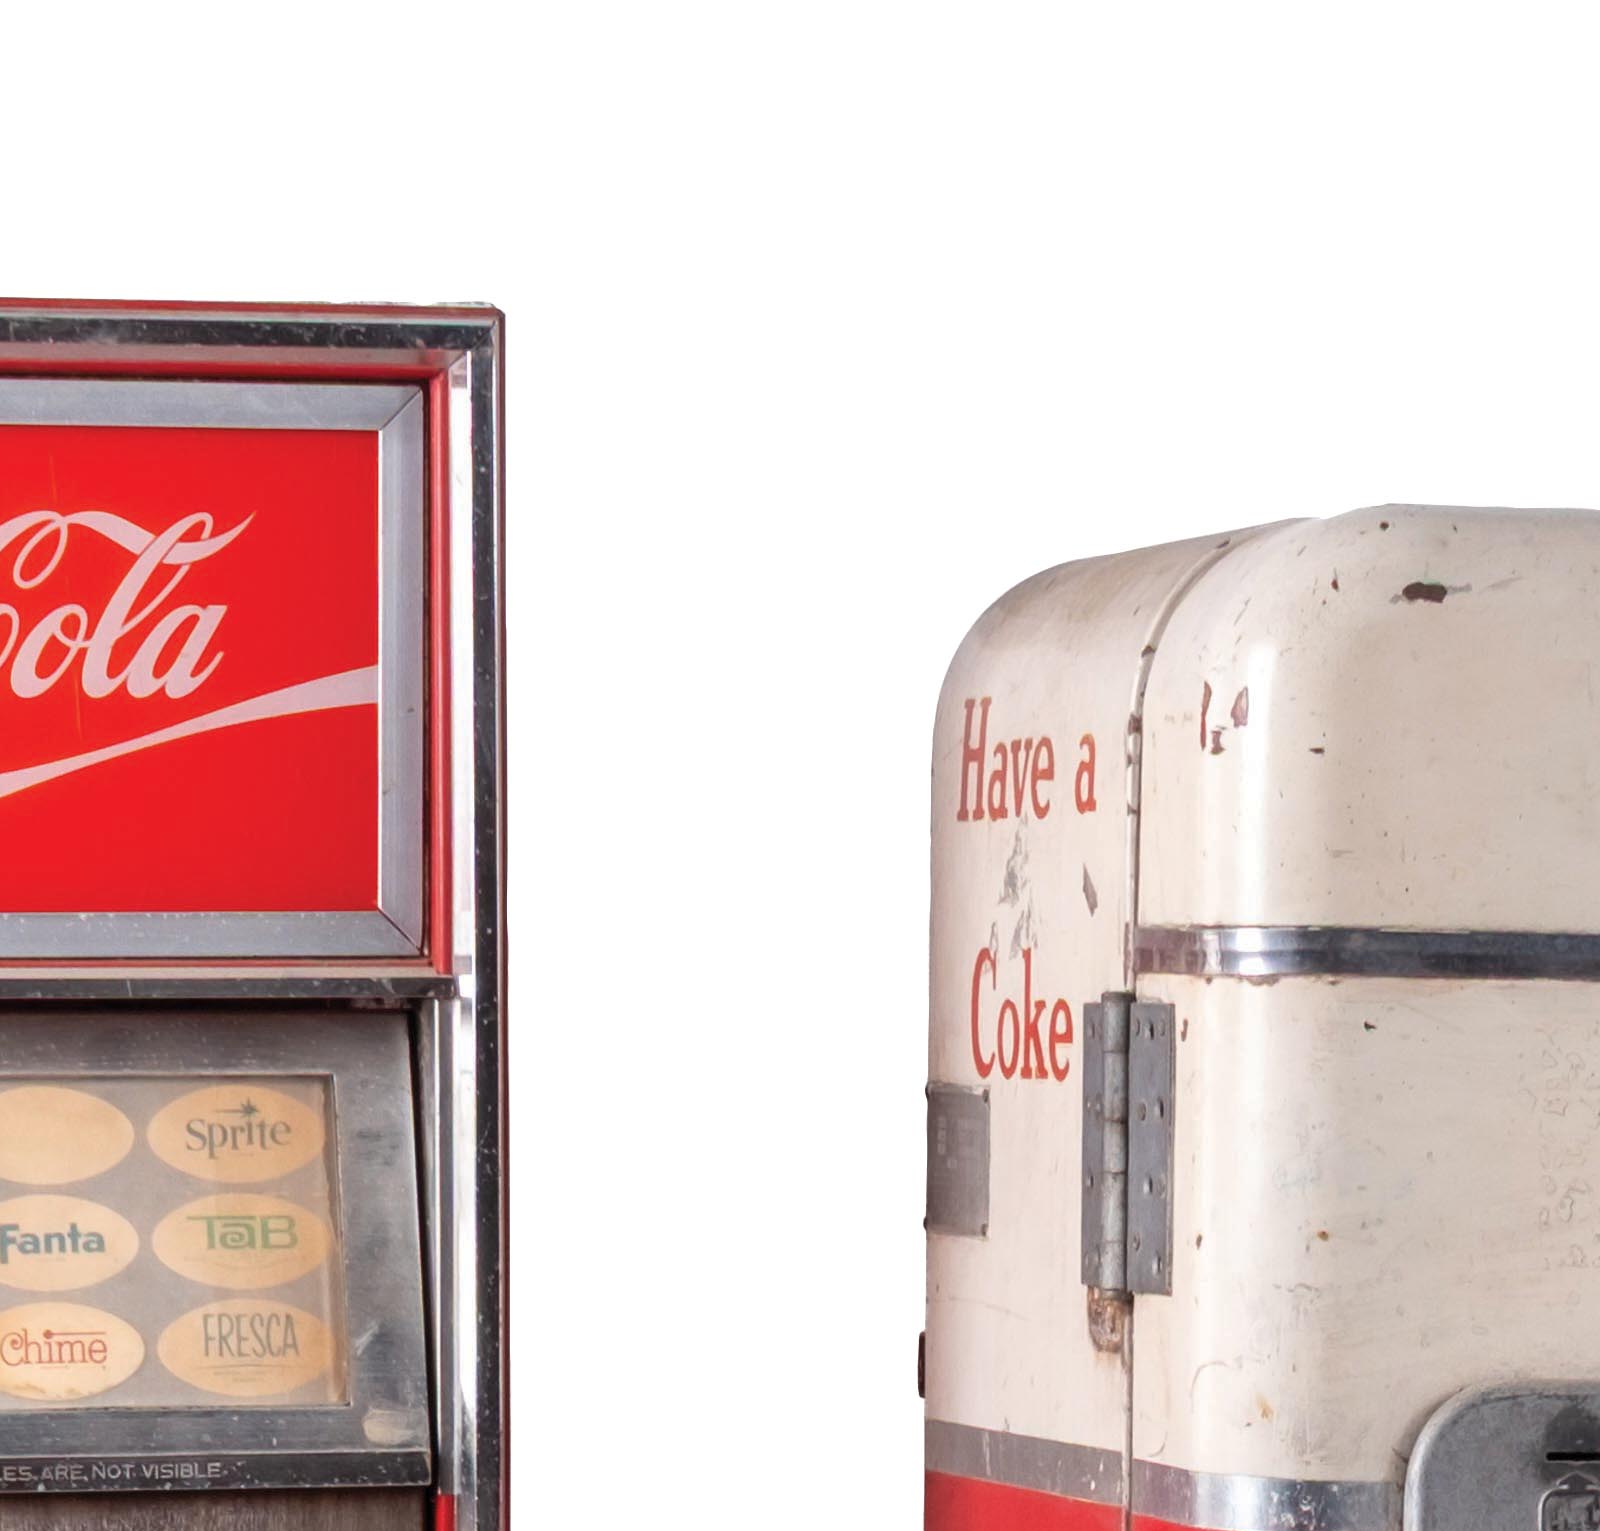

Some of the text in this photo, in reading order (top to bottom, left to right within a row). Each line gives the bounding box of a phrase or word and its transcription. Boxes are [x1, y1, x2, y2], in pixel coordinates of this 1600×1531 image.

[956, 696, 1097, 822] Have a
[971, 947, 1074, 1082] Coke
[185, 1106, 292, 1160] Sprite
[0, 1327, 108, 1367] Chime
[202, 1312, 300, 1358] FRESCA
[41, 1464, 84, 1481] ARE
[91, 1463, 135, 1480] NOT
